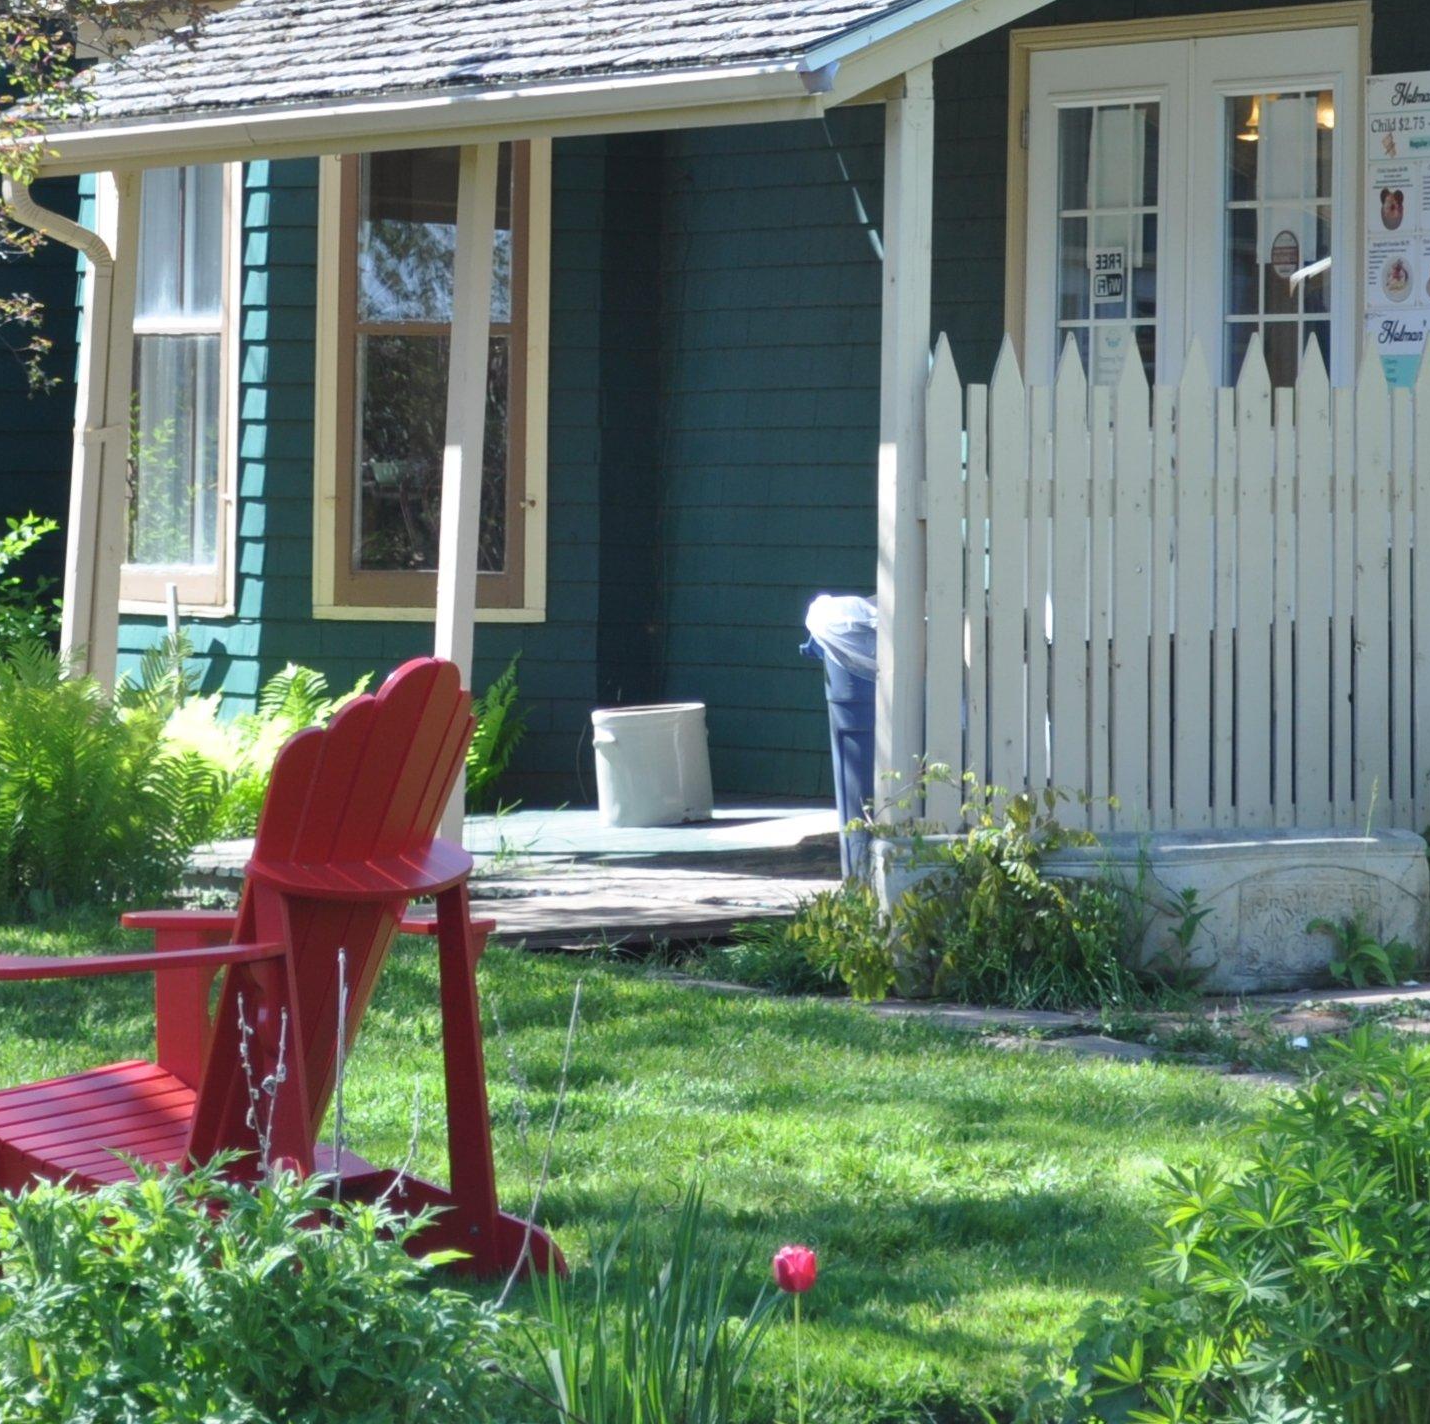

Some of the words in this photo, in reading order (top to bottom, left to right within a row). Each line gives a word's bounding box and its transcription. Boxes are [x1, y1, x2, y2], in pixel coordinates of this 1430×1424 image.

[1371, 118, 1396, 133] Child
[1399, 116, 1426, 132] $2.75
[1378, 319, 1428, 344] Holman'
